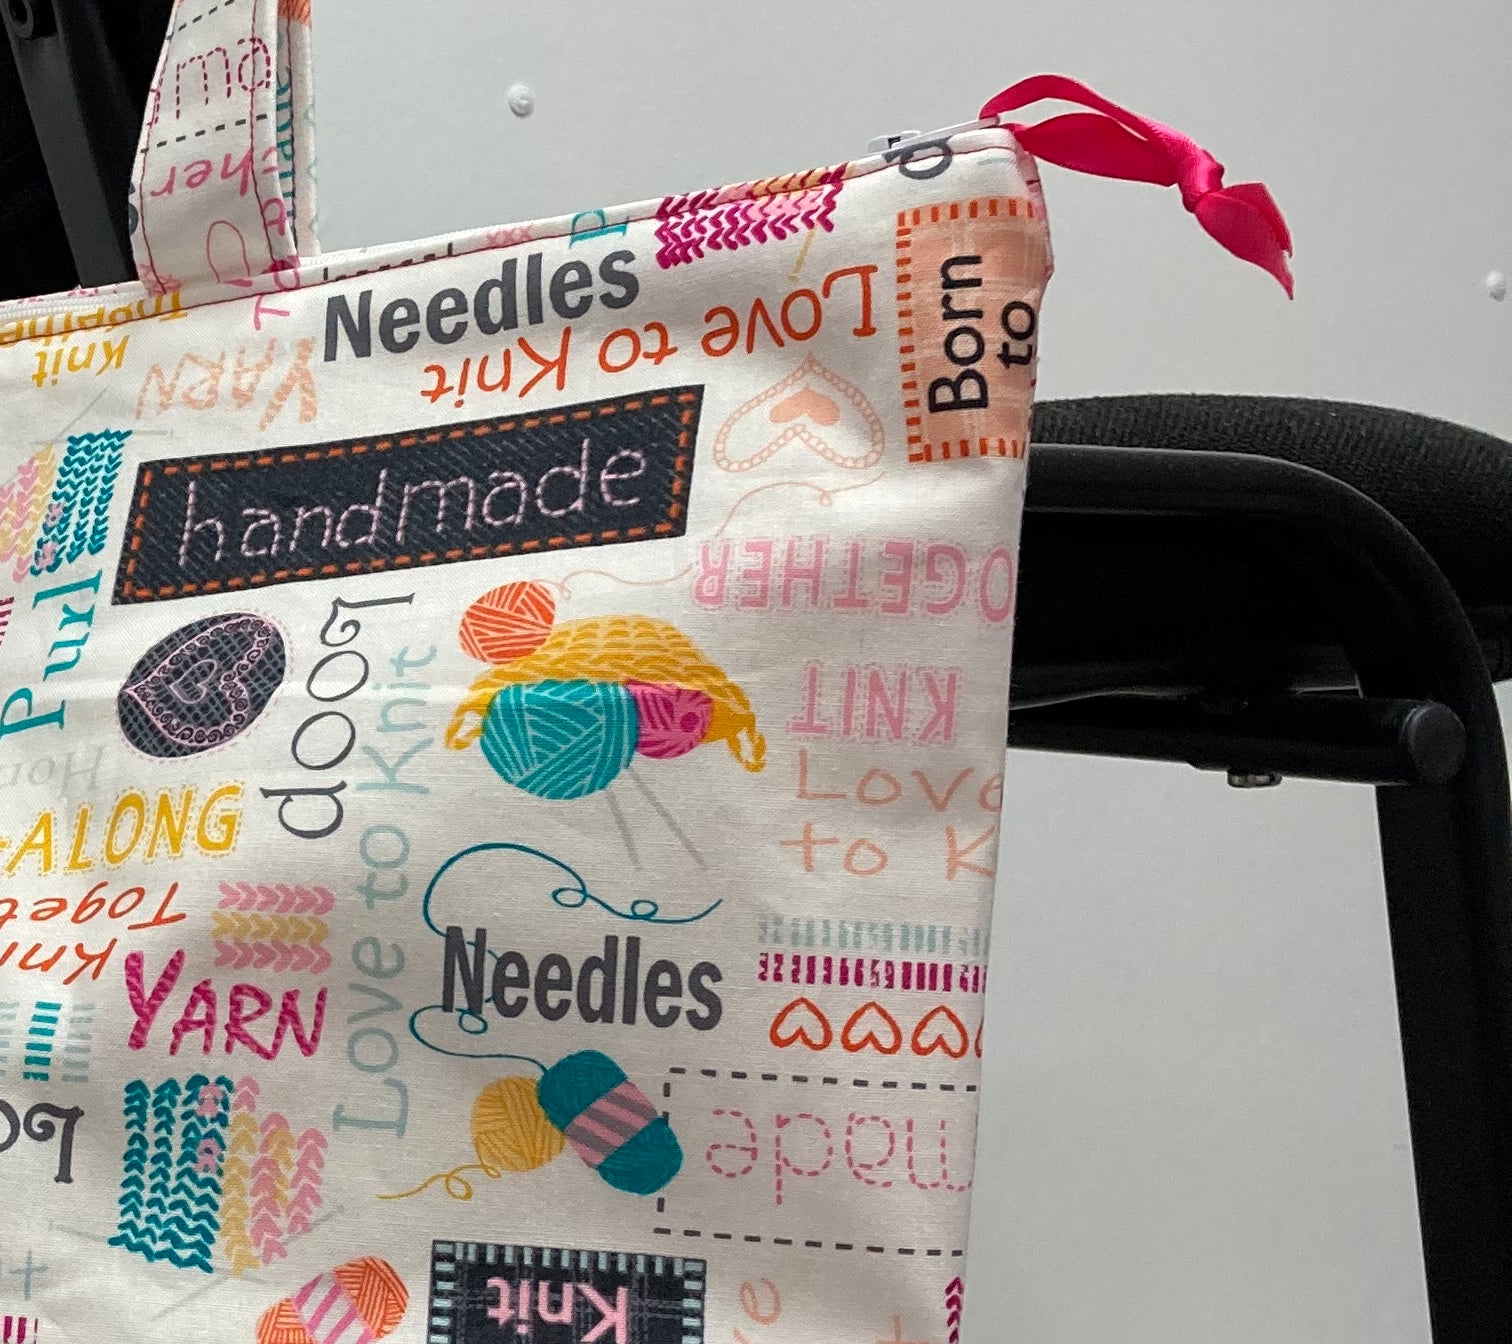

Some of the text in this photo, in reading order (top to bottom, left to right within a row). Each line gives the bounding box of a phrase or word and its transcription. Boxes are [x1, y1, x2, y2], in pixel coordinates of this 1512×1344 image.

[323, 249, 640, 363] Needles
[420, 264, 879, 408] Love to Knit
[928, 254, 989, 413] Born
[996, 300, 1039, 369] to
[32, 335, 129, 388] Knit
[135, 337, 320, 432] YARN
[178, 438, 648, 566] handmade
[693, 537, 1012, 623] OGETHER
[259, 592, 415, 839] Loop
[792, 663, 958, 743] KNIT
[333, 646, 437, 1139] Love to Knit
[779, 821, 887, 875] to
[123, 949, 327, 1060] YARN
[442, 926, 723, 1030] Needles
